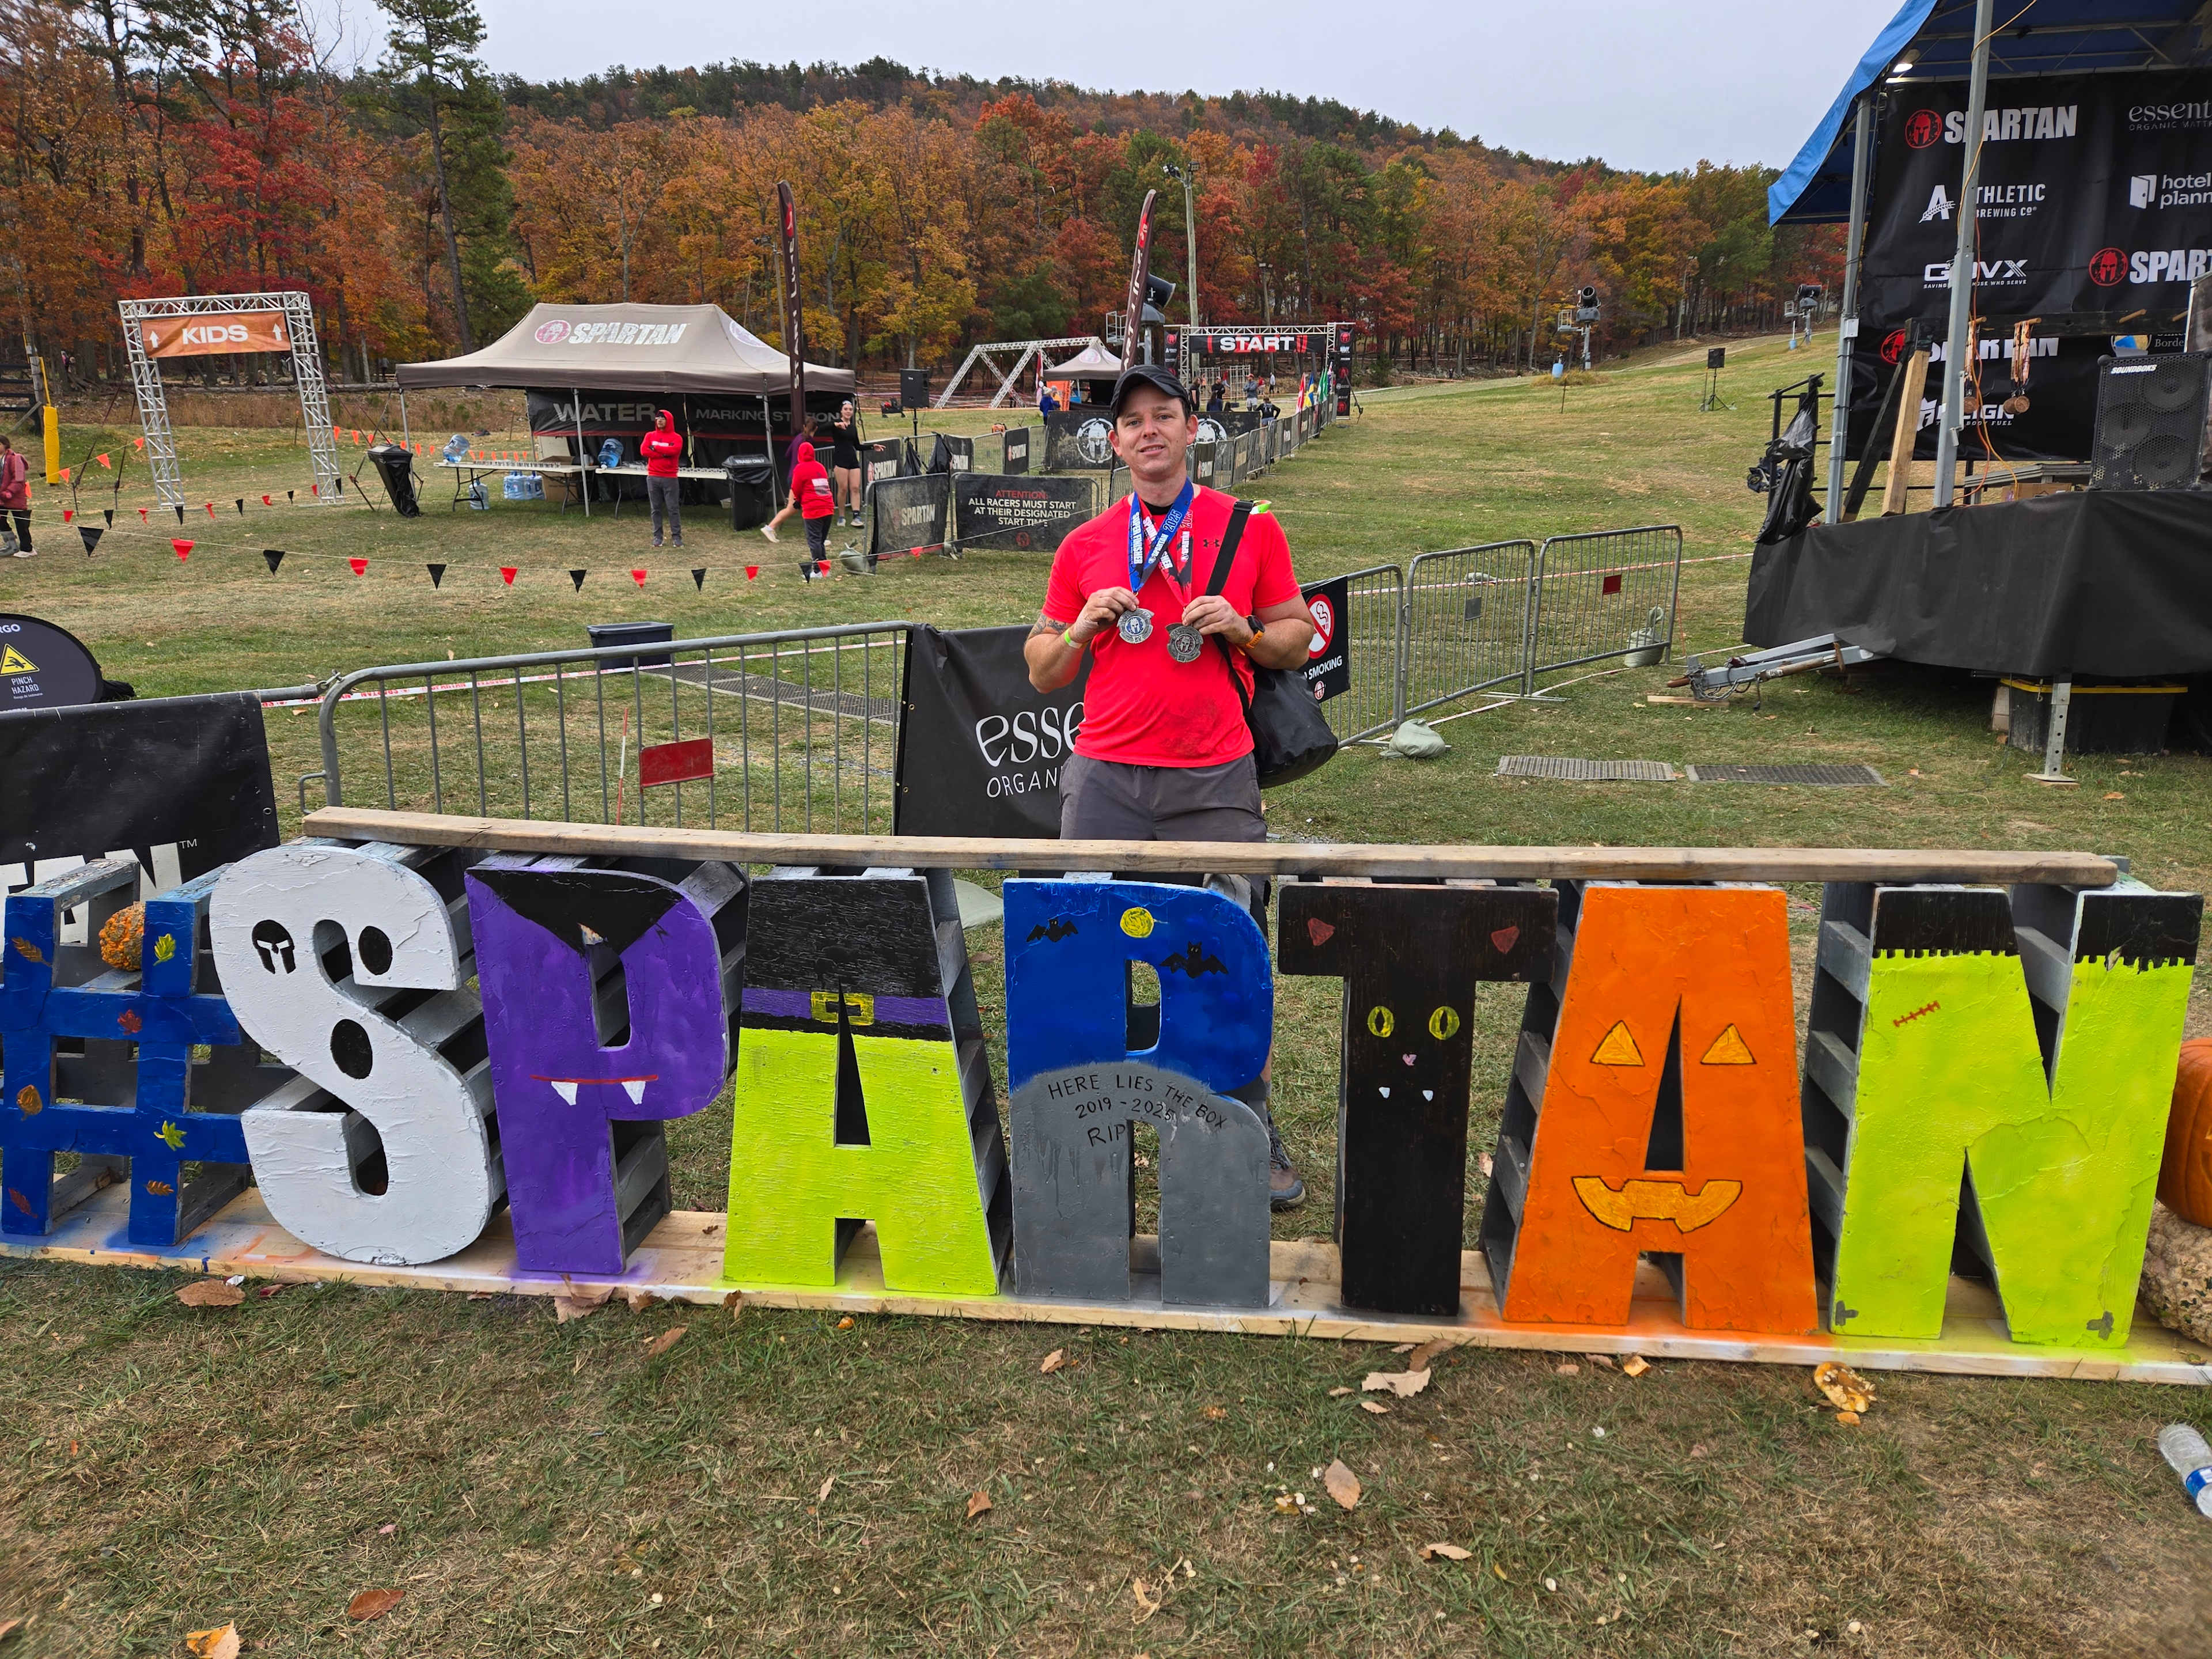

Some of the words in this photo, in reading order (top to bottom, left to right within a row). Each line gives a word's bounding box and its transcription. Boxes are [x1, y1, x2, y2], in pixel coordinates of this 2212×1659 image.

[1944, 105, 2078, 144] SARTAN
[2162, 172, 2211, 190] hotel
[1976, 183, 2046, 204] THLETIC
[182, 324, 248, 344] KIDS
[569, 322, 687, 344] SPARTAN
[1220, 337, 1294, 351] START
[553, 403, 656, 422] WATER
[696, 409, 767, 421] MARKING
[772, 411, 841, 422] STION
[874, 460, 897, 480] SPARTAN
[968, 498, 985, 506] ALL
[987, 499, 1021, 508] RACERS
[1022, 500, 1048, 509] MUST
[1049, 501, 1077, 510] START
[974, 507, 986, 515] AT
[986, 507, 1013, 517] THEIR
[1014, 509, 1071, 519] DESIGNATED
[901, 504, 935, 526] SPARTAN
[998, 517, 1025, 526] START
[1163, 509, 1183, 533] 2025
[1308, 655, 1343, 680] SMOKING
[11, 676, 33, 685] PINCH
[11, 684, 39, 695] HAZARD
[986, 766, 1063, 798] ORGAN
[1047, 1074, 1100, 1100] HERE
[1116, 1074, 1153, 1092] LIES
[1165, 1085, 1194, 1109] THE
[1195, 1103, 1229, 1130] BOX
[1075, 1097, 1112, 1119] 2019
[1131, 1098, 1176, 1121] 2025
[1087, 1124, 1127, 1147] RIP
